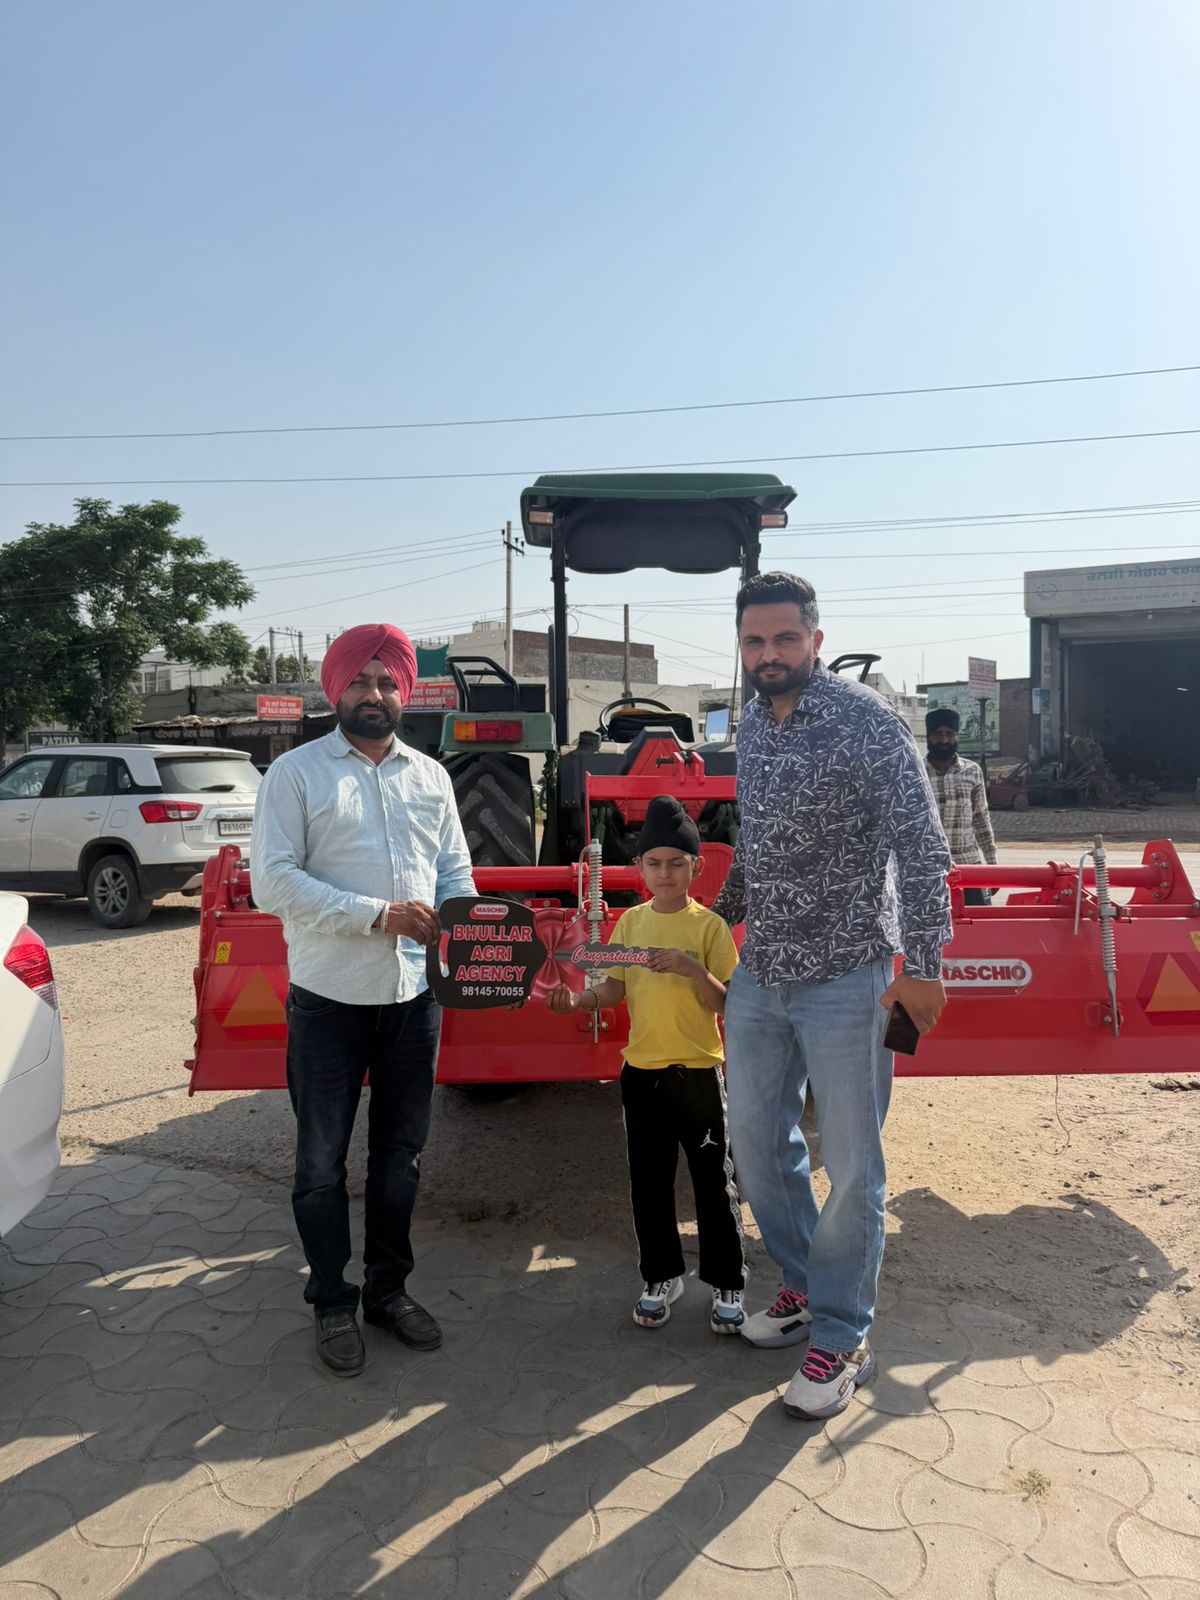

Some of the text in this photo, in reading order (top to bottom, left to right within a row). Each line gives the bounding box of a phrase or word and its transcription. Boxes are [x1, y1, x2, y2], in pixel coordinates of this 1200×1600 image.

[41, 736, 80, 747] PATIALA
[475, 906, 507, 914] MASCHIO
[452, 924, 532, 942] BHULLAR
[470, 945, 512, 962] AGRI
[571, 945, 649, 966] Congratulati
[455, 965, 527, 982] AGENCY
